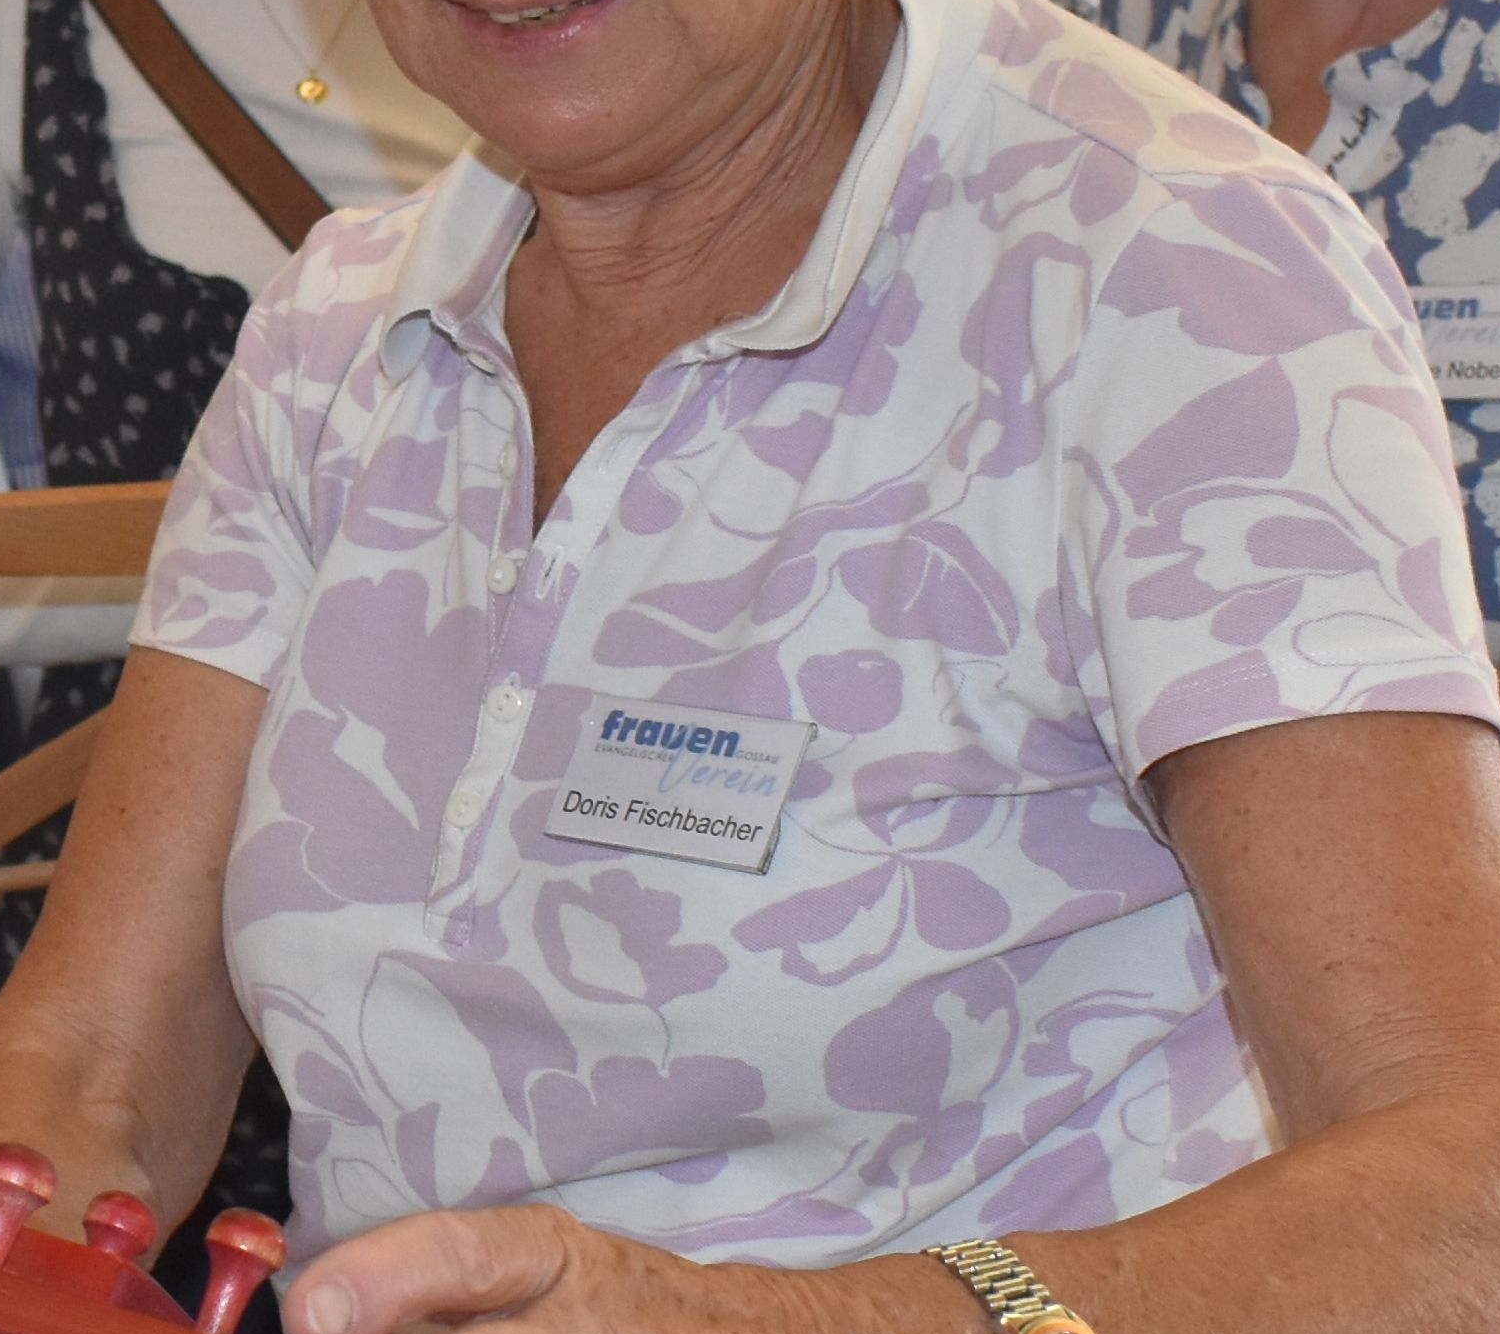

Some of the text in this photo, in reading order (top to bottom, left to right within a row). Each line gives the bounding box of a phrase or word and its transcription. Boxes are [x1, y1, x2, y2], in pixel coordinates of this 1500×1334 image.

[1414, 296, 1480, 319] uen
[600, 709, 741, 759] frauen
[657, 741, 779, 797] Verein
[562, 789, 764, 844] Doris Fischbacher
